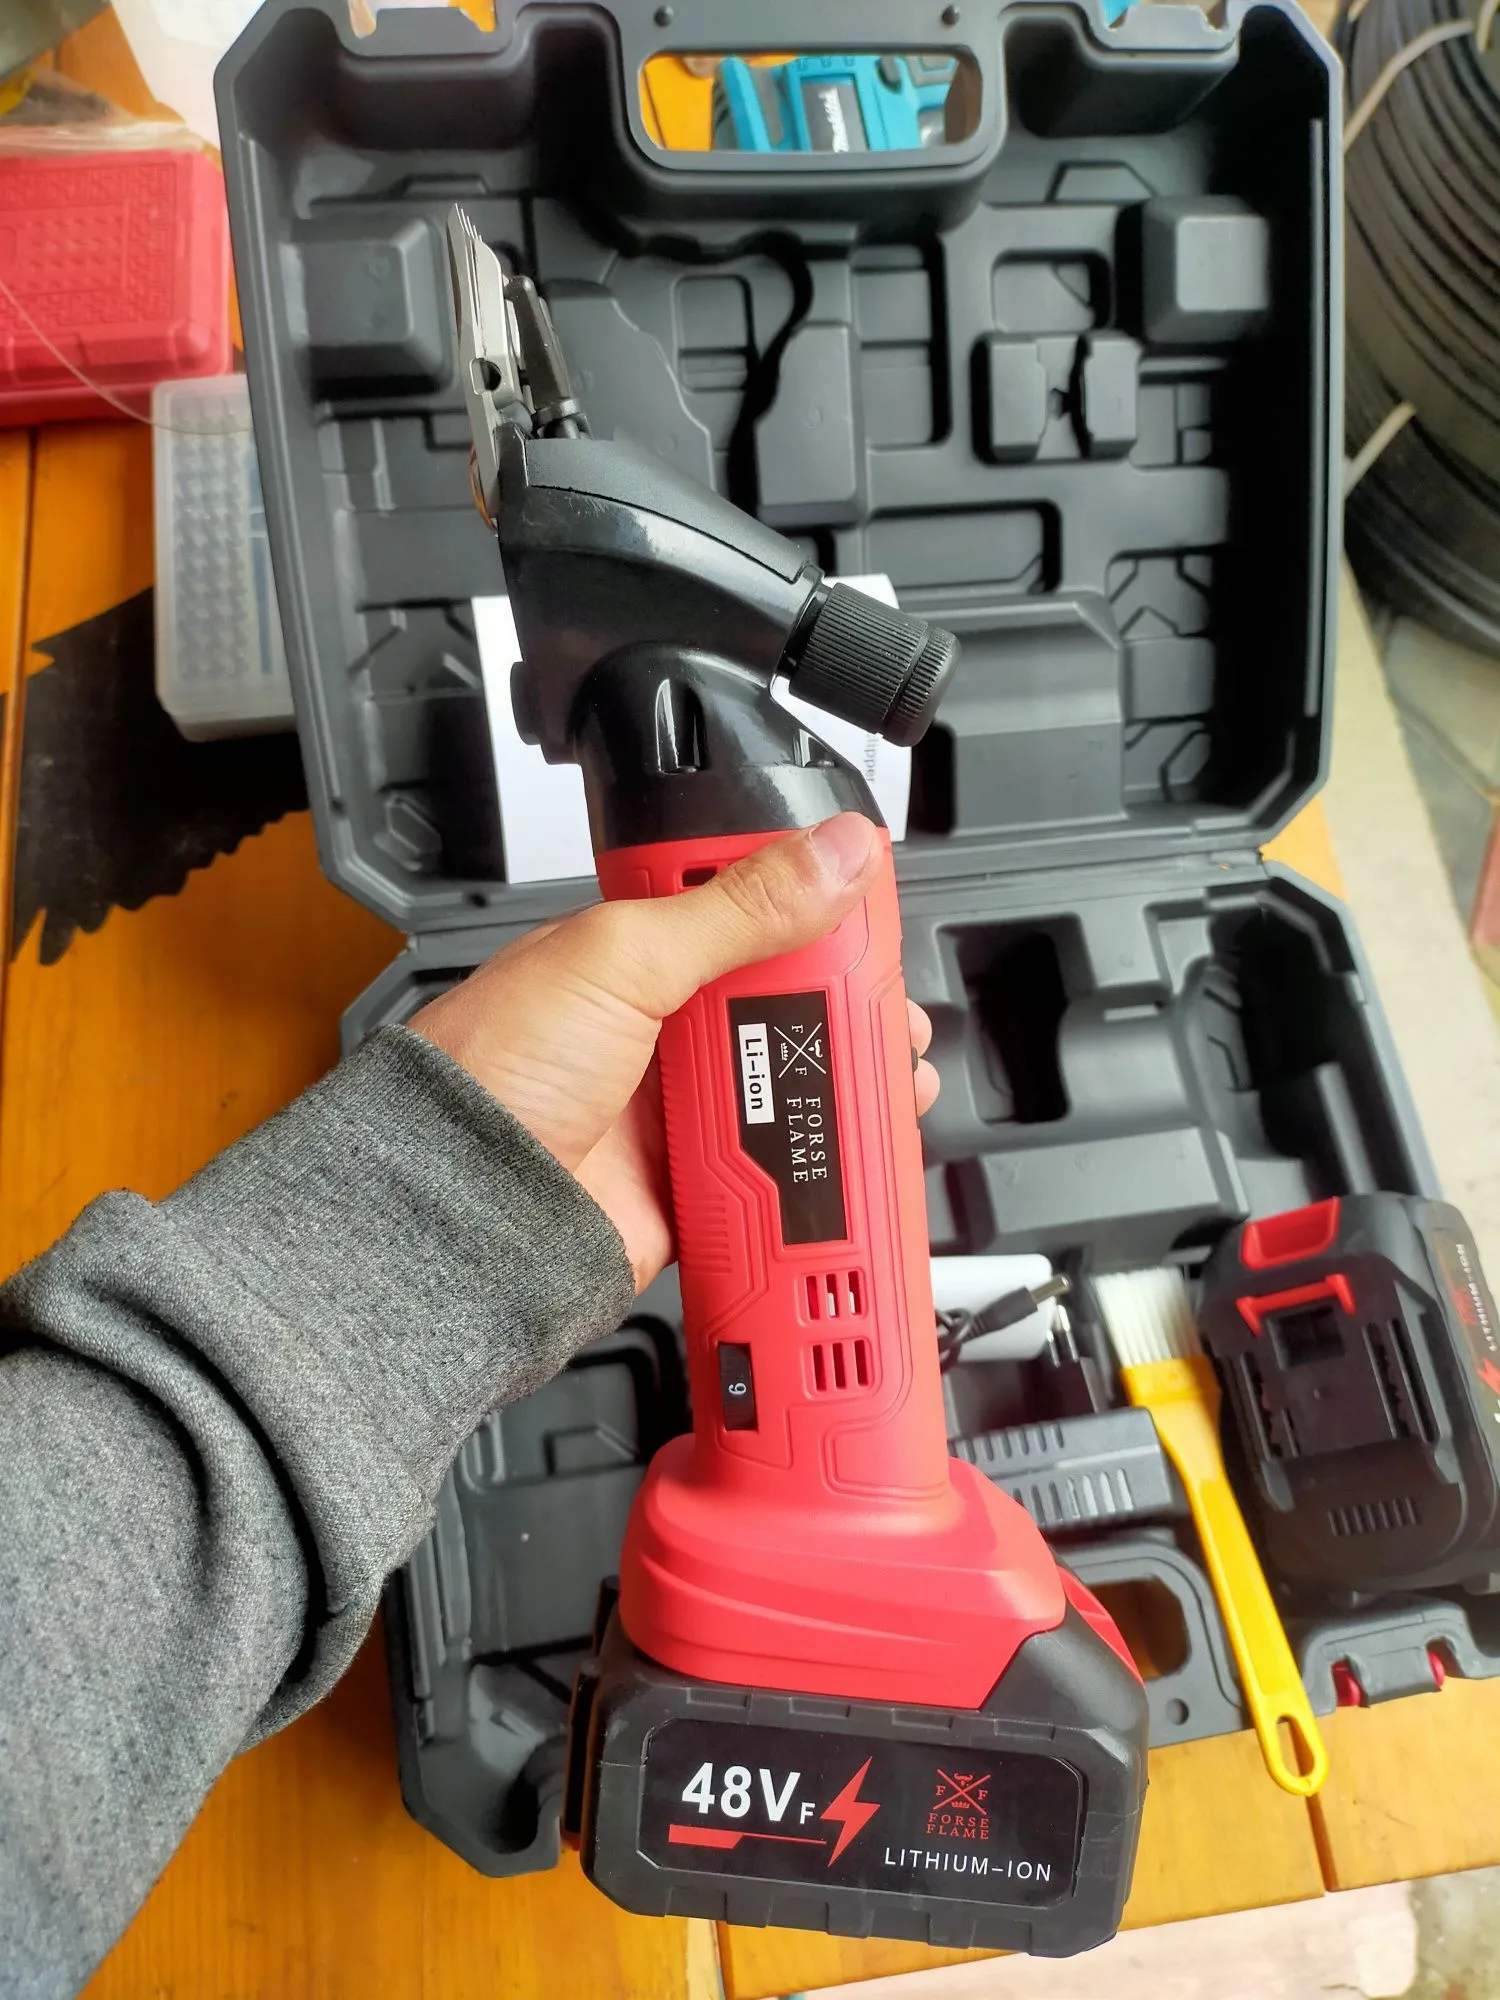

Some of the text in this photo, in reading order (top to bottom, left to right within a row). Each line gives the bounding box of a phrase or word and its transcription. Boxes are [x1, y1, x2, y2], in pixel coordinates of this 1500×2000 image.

[744, 1038, 765, 1110] Li-ion
[786, 1096, 809, 1183] FLAME
[805, 1096, 828, 1180] FORSE
[926, 1823, 990, 1840] FLAME
[928, 1812, 990, 1829] FORSE
[884, 1847, 1051, 1882] LITHIUM-ION
